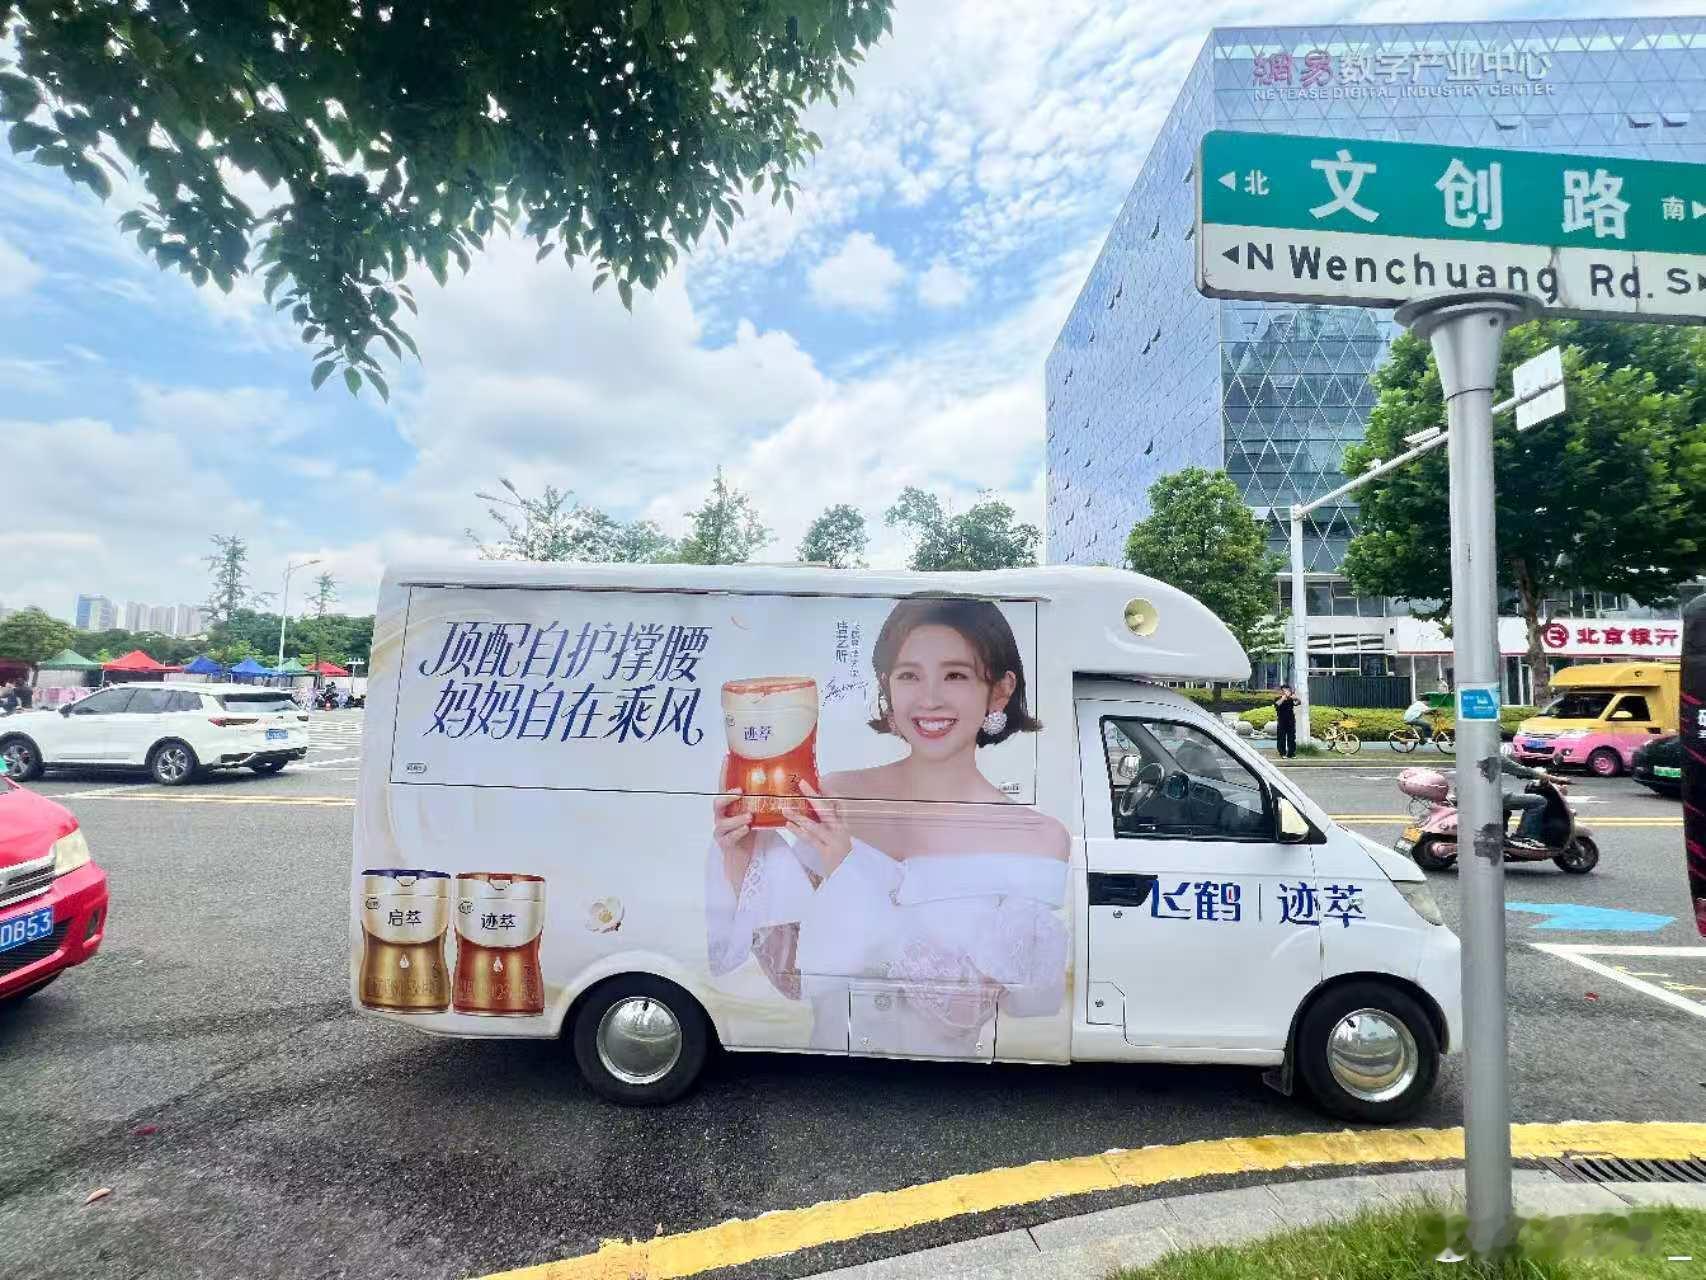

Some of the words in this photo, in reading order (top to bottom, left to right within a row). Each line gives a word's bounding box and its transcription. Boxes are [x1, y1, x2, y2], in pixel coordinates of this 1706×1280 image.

[1254, 88, 1329, 101] NETEASE
[1333, 86, 1396, 99] DIGITAL
[1401, 85, 1484, 98] INDUSTRY
[1488, 83, 1556, 97] CENTER
[1244, 169, 1270, 196] 北
[1309, 148, 1632, 240] 文创路
[1661, 195, 1687, 221] 南
[1247, 242, 1273, 271] N
[1288, 244, 1559, 304] Wenchuang
[1590, 263, 1654, 299] Rd.
[1667, 267, 1692, 295] S
[419, 620, 713, 683] 顶配自护撑腰
[1577, 627, 1679, 646] 北京银行
[422, 678, 705, 746] 妈妈自在乘风
[387, 908, 423, 928] 启萃
[480, 912, 517, 931] 迹萃
[1150, 878, 1241, 922] 飞鹤
[1277, 880, 1367, 929] 迹萃
